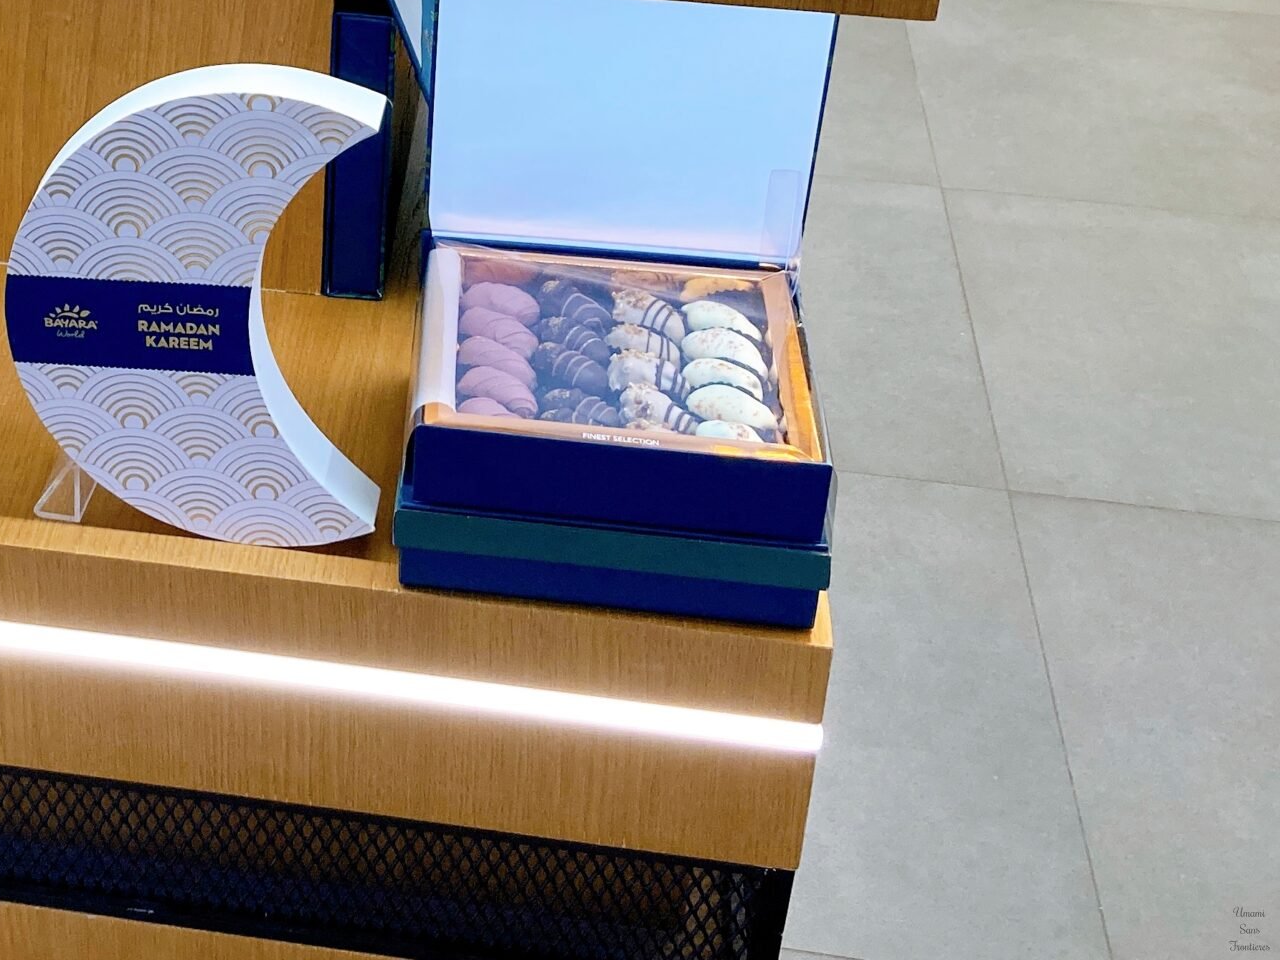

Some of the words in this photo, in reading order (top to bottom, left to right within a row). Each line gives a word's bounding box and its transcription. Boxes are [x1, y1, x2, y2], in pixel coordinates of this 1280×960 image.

[138, 302, 174, 315] كريم
[175, 303, 220, 318] رمضان
[44, 317, 97, 330] BAYARA
[137, 320, 221, 336] RAMADAN
[56, 328, 85, 339] World
[145, 335, 213, 351] KAREEM
[582, 432, 611, 441] FINEST
[613, 435, 660, 446] SELECTION
